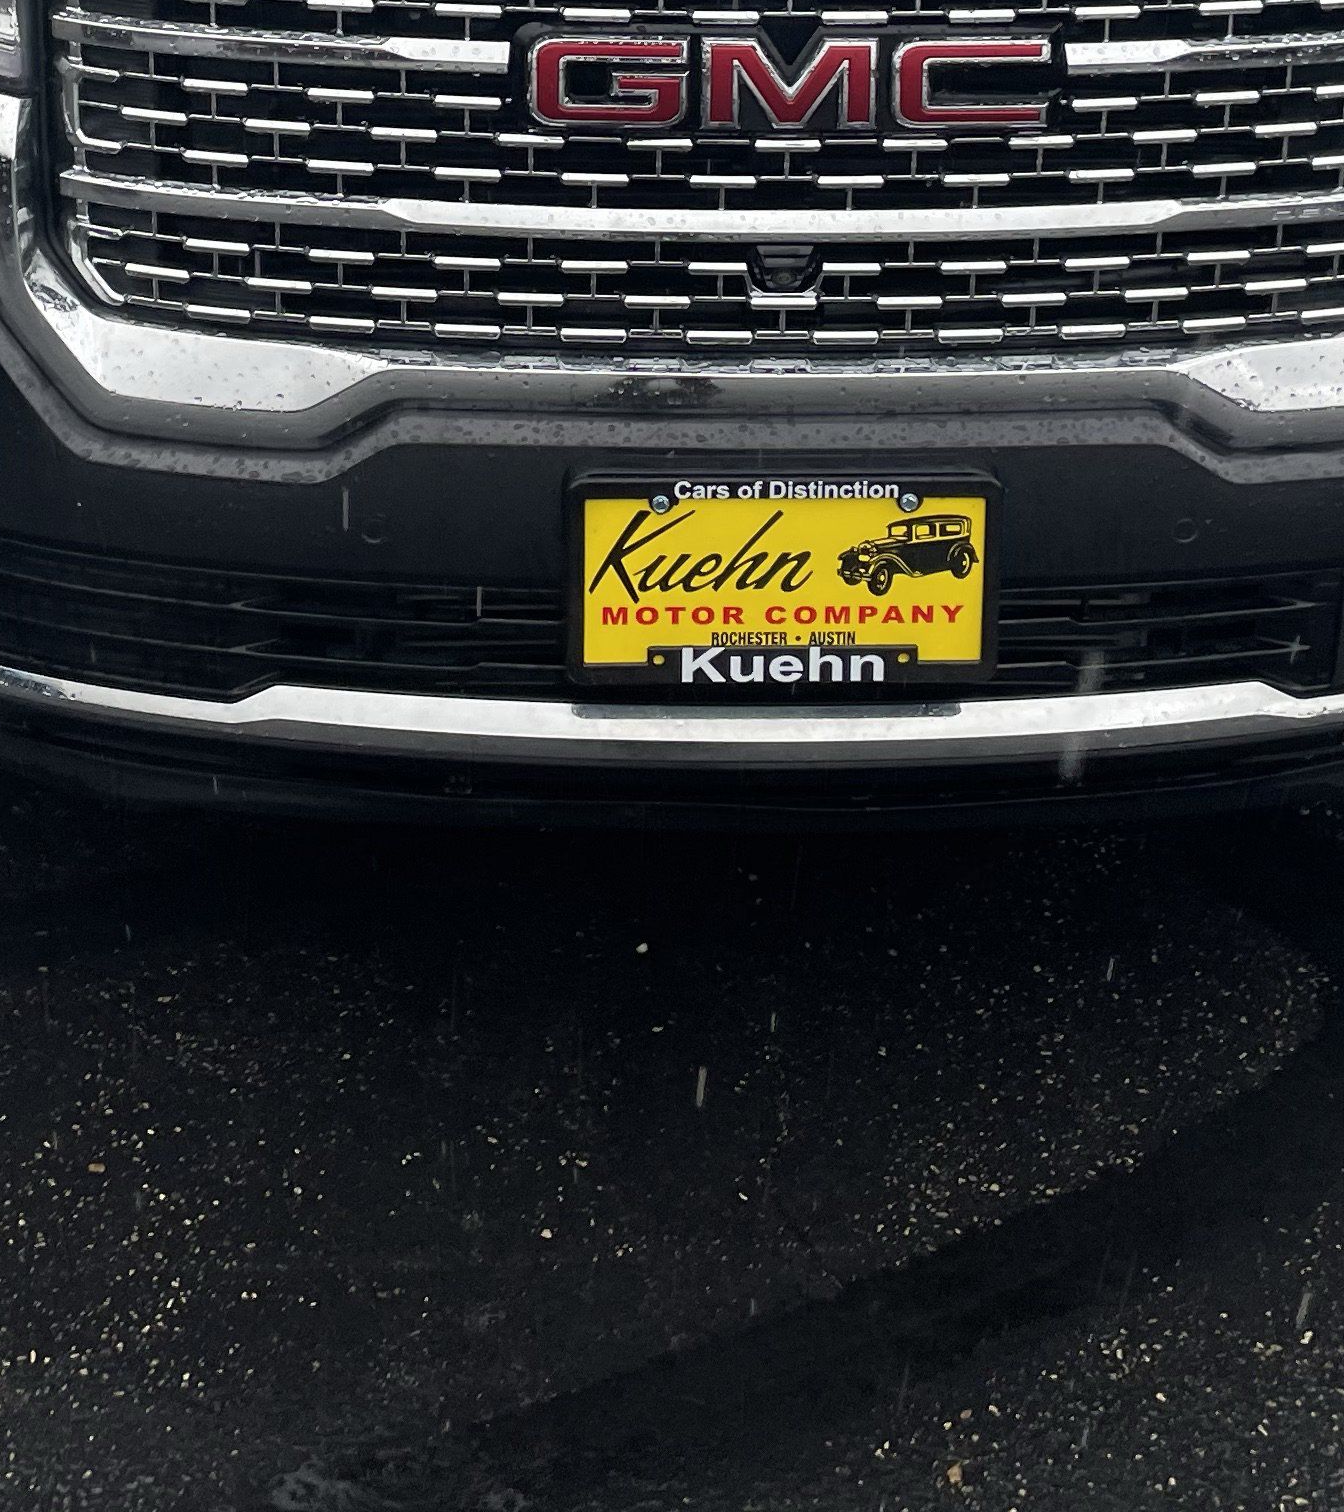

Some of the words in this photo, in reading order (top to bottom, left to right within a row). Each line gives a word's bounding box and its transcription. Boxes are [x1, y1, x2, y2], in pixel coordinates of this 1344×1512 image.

[528, 35, 1053, 130] GMC
[673, 481, 731, 500] Cars
[737, 480, 762, 499] of
[769, 480, 899, 499] Distinction
[589, 509, 814, 604] Kuehn
[601, 606, 744, 625] MOTOR
[765, 605, 965, 624] COMPANY
[710, 631, 788, 646] ROCHESTER
[808, 631, 856, 645] AUSTIN
[680, 647, 885, 683] Kuehn
